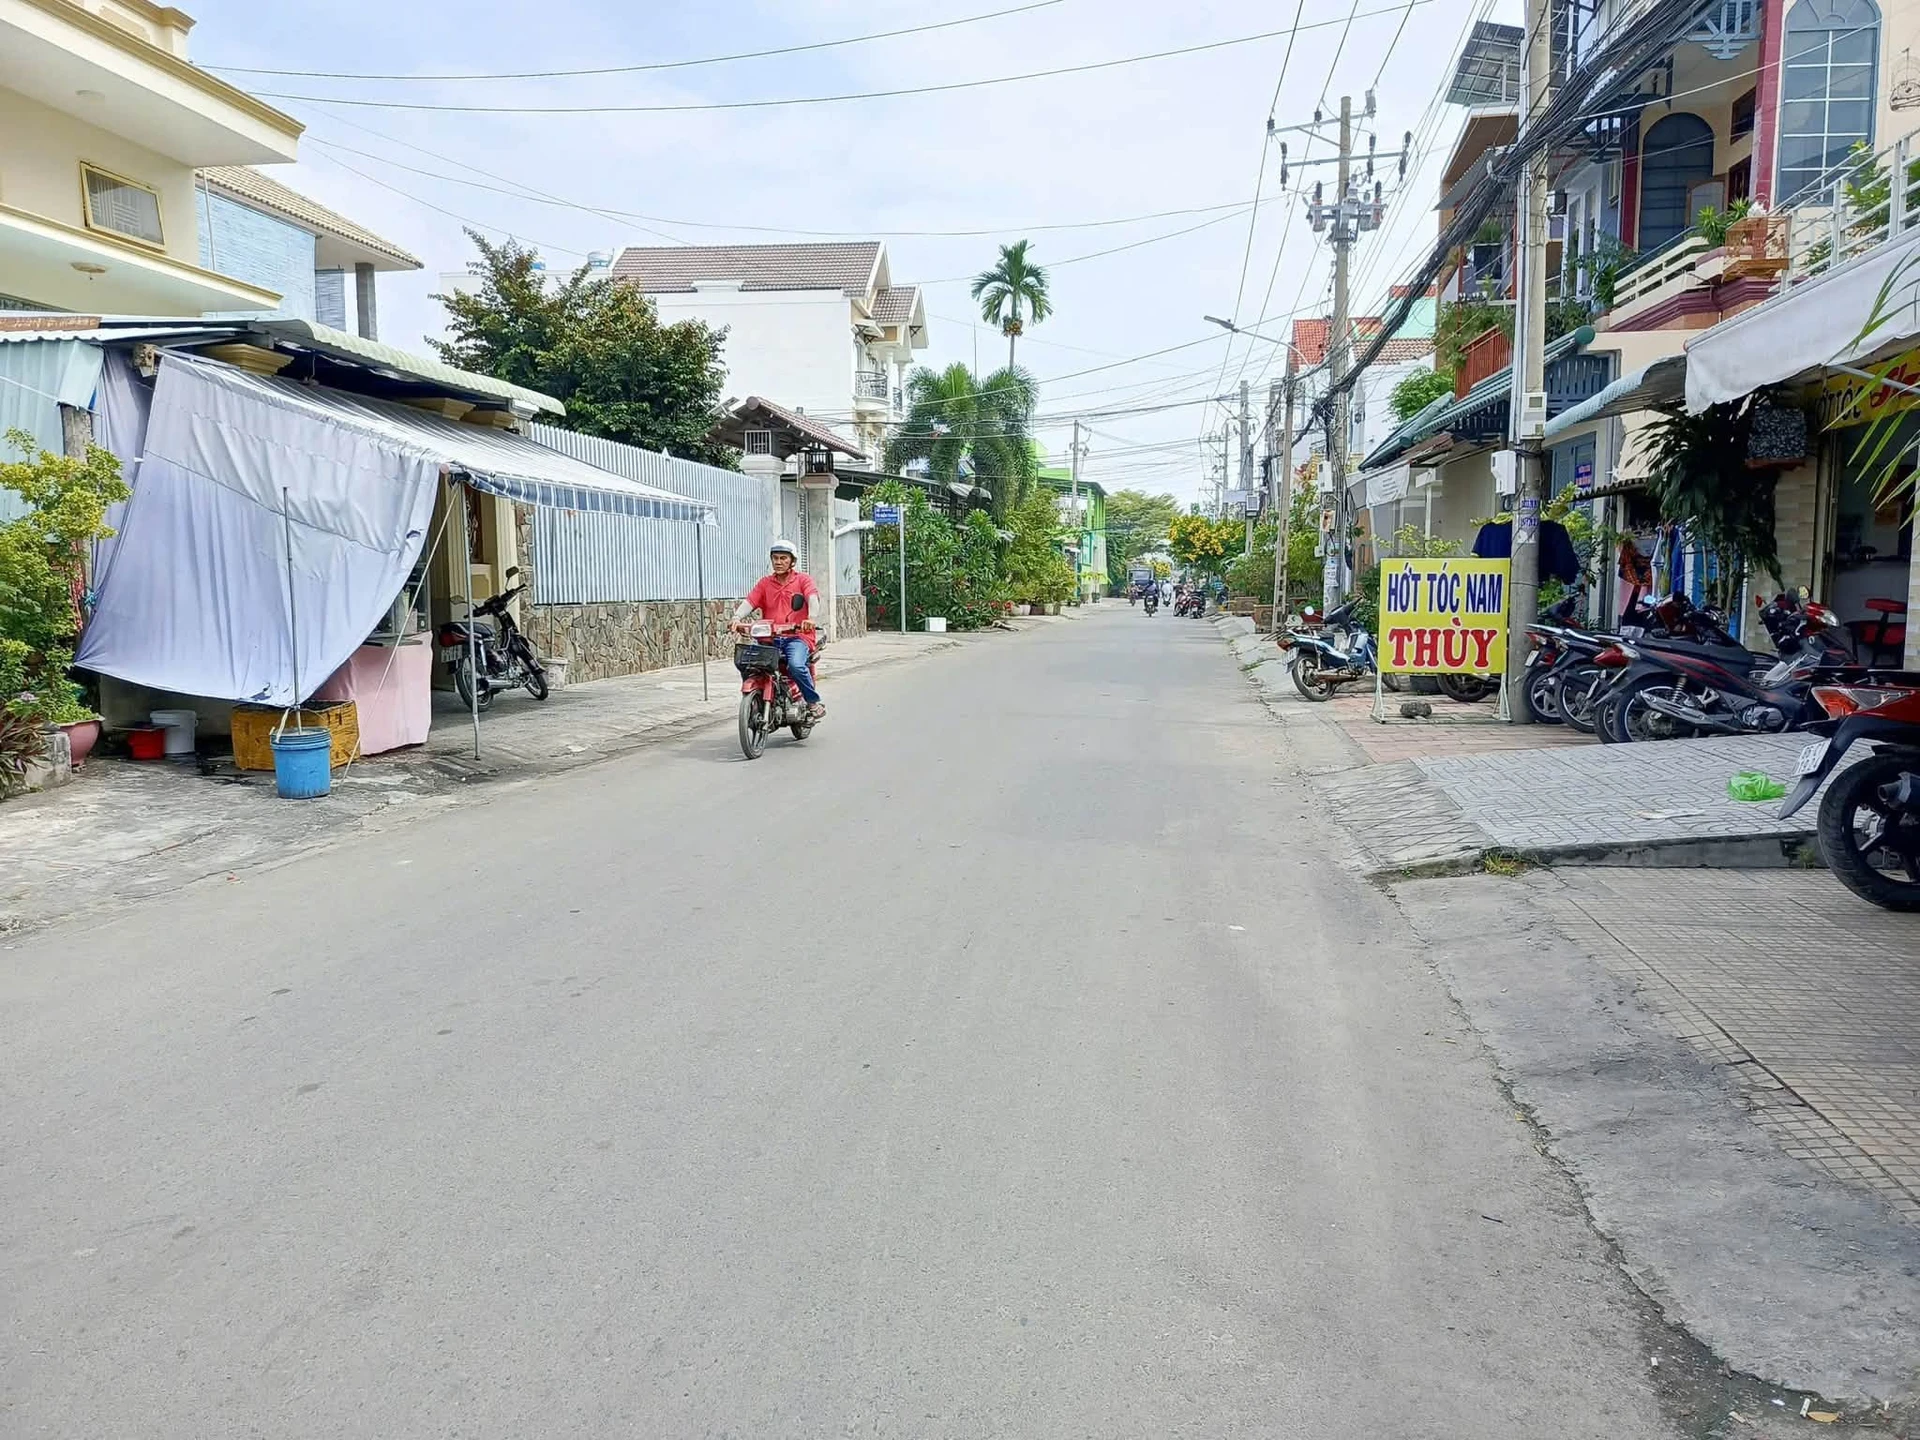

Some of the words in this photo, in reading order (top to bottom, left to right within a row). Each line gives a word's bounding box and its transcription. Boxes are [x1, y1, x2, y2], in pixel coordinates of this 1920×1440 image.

[1387, 562, 1421, 613] HỚT
[1427, 562, 1461, 613] TÓC
[1465, 573, 1503, 613] NAM
[1388, 617, 1498, 668] THÙY
